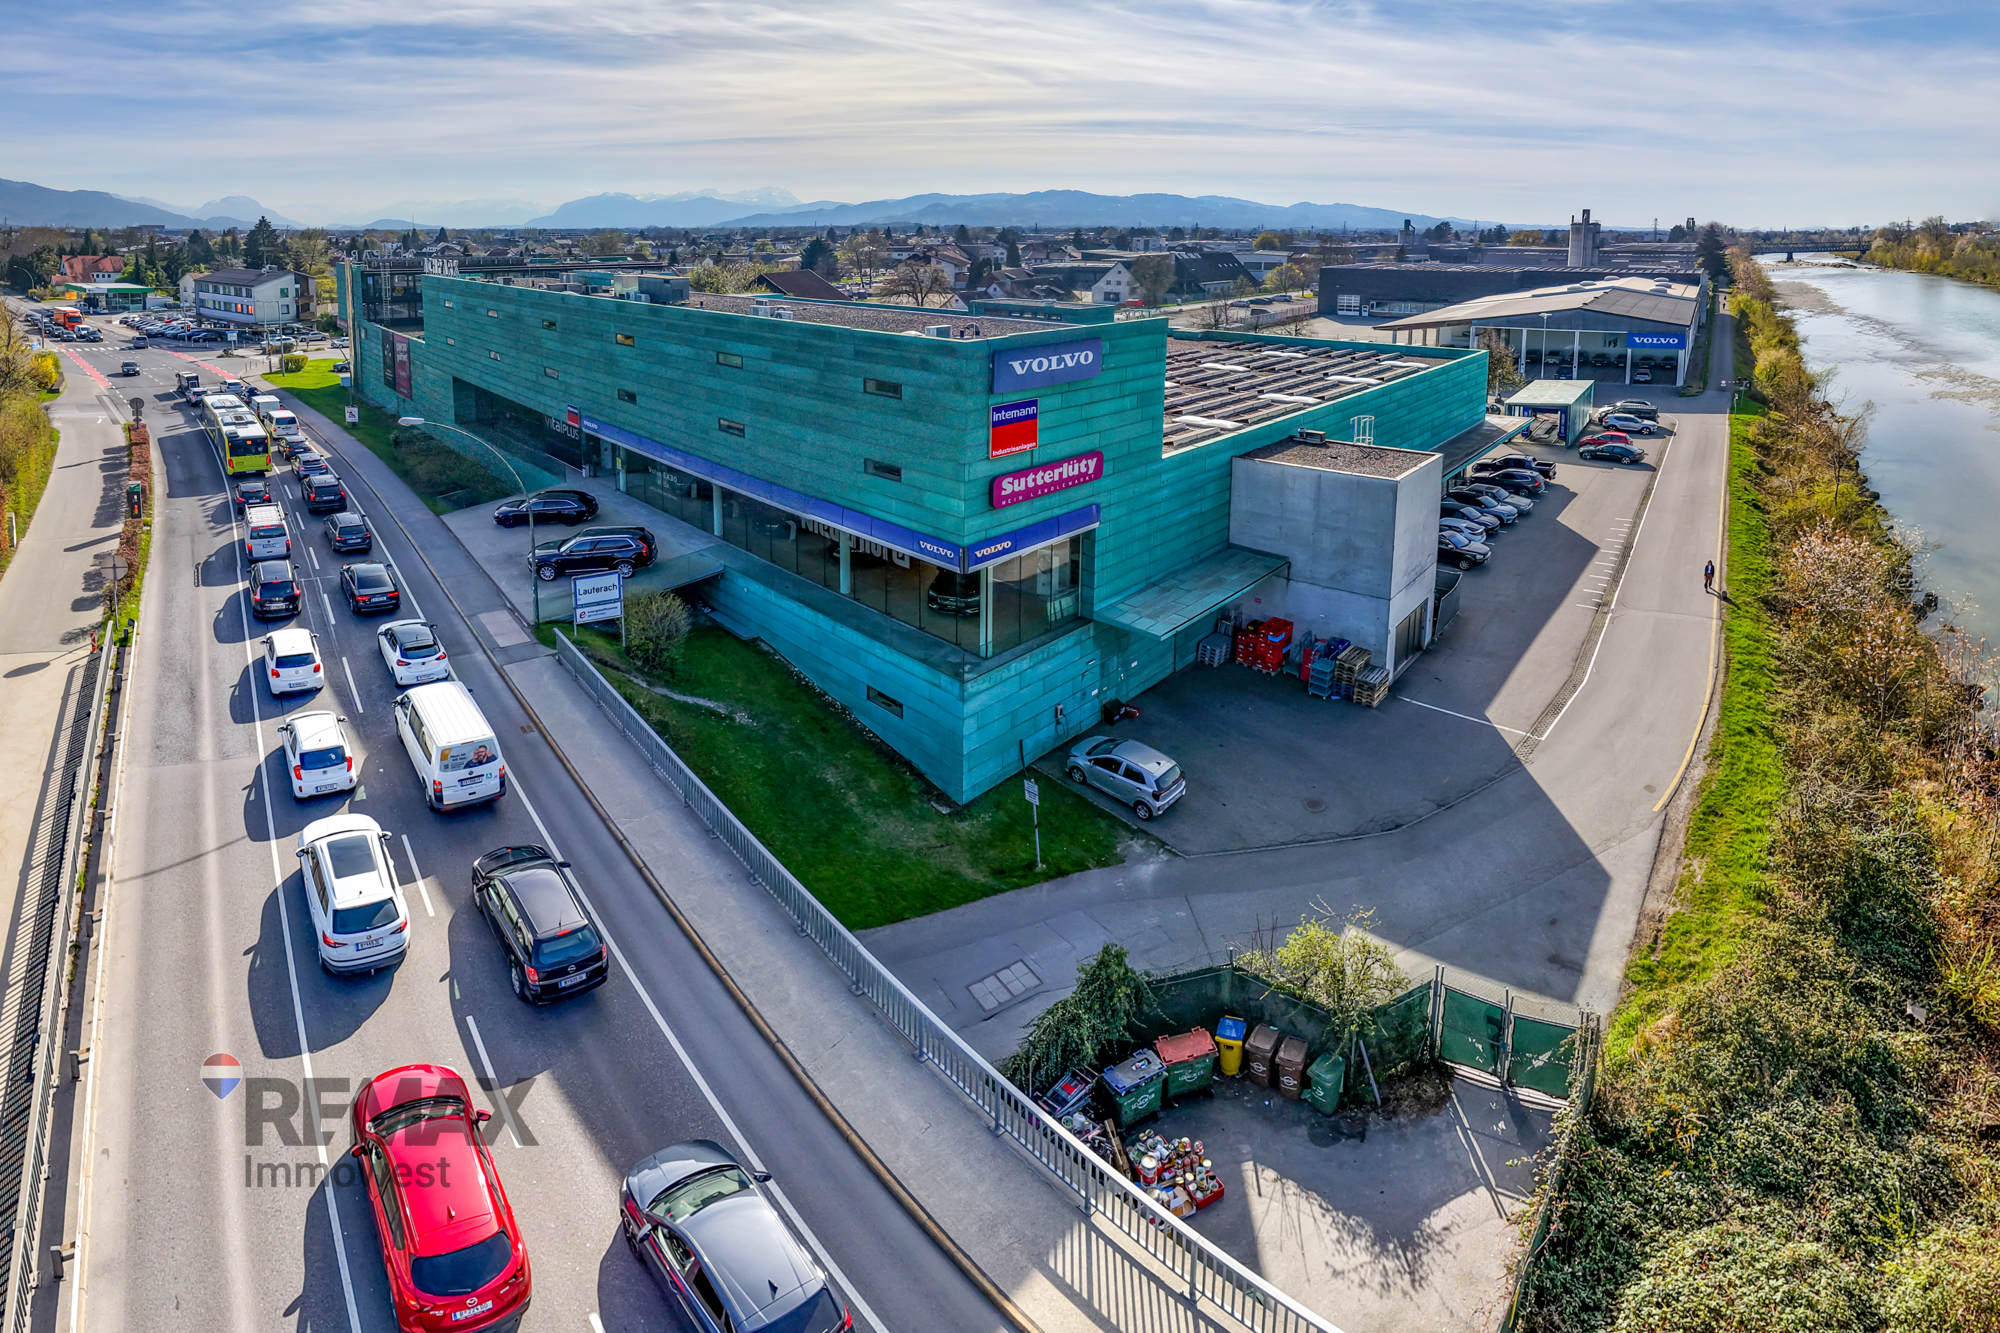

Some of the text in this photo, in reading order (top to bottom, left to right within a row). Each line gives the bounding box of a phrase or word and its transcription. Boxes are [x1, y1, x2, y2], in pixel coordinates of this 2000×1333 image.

[1633, 336, 1679, 344] VOLVO
[1009, 351, 1093, 375] VOLVO
[993, 406, 1037, 421] intemann
[992, 442, 1036, 456] Industrieanlagen
[1001, 457, 1097, 496] Sutterlüty
[1001, 495, 1023, 506] MEIN
[919, 540, 955, 558] VOLVO
[974, 540, 1012, 558] VOLVO
[578, 583, 618, 596] Lauterach
